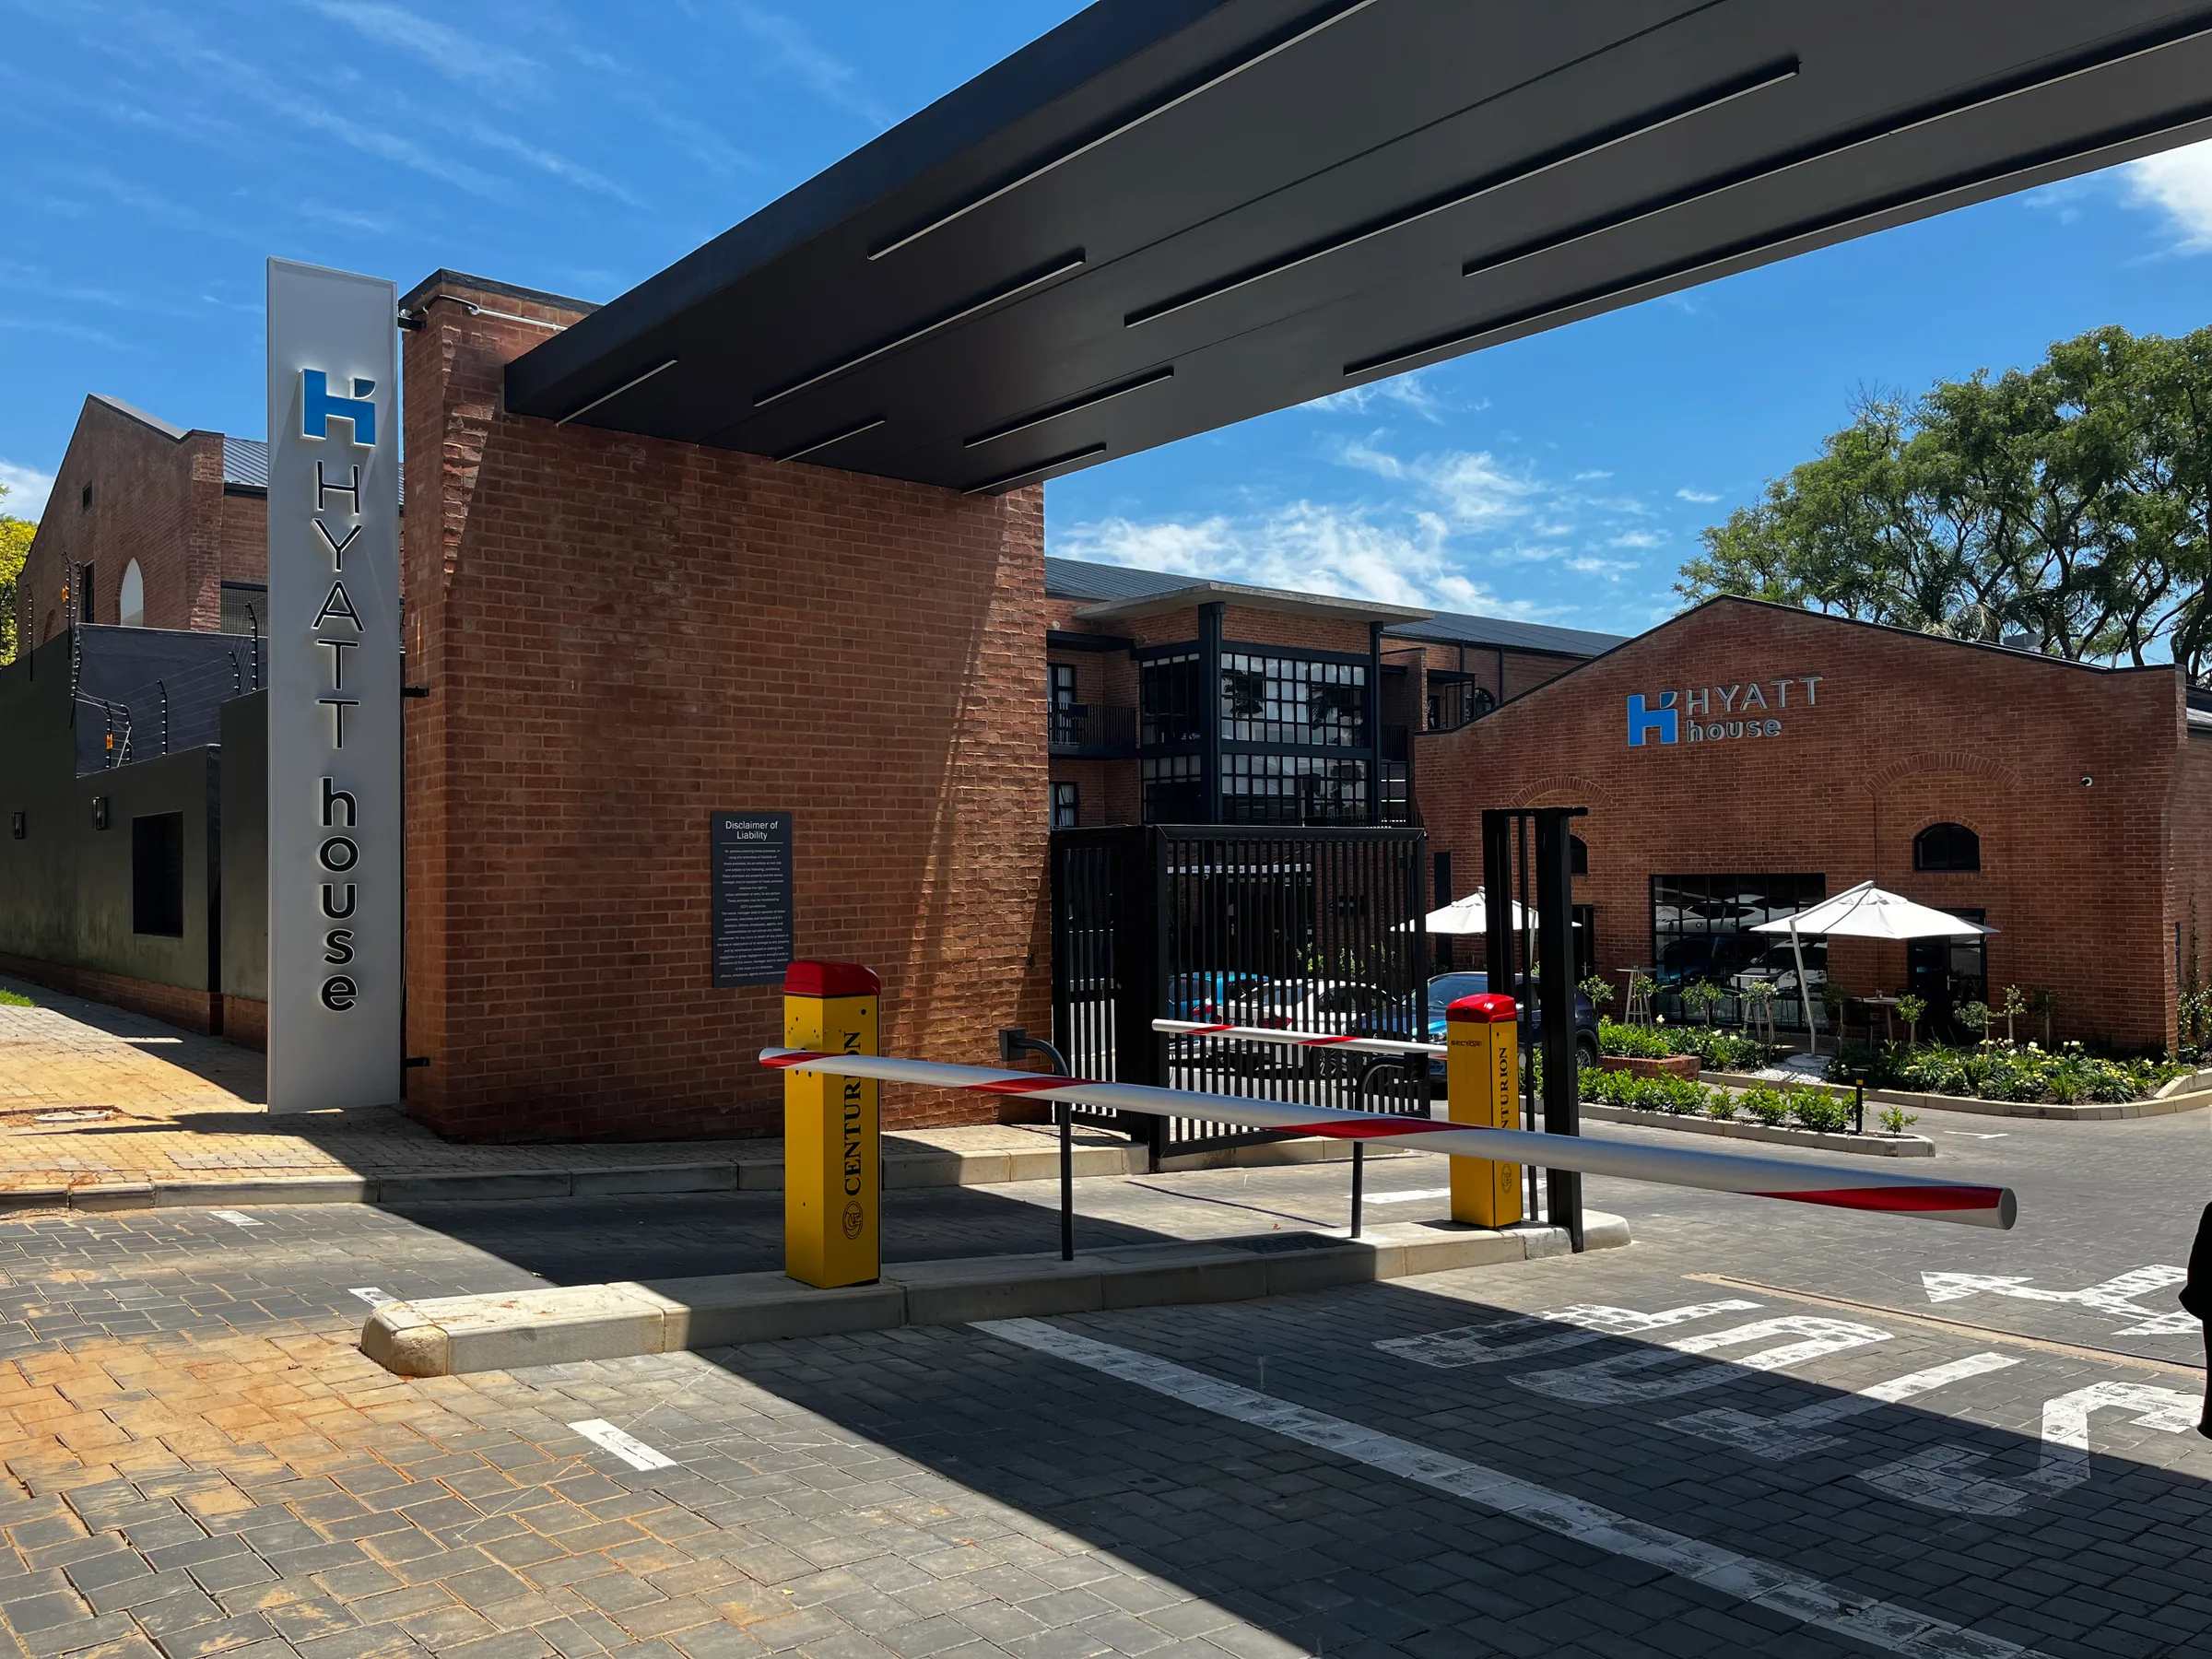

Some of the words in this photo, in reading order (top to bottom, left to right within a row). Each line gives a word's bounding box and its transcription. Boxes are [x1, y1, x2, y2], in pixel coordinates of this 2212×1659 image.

[312, 460, 365, 749] HYATT
[1686, 677, 1823, 715] HYATT
[1686, 718, 1782, 742] house
[725, 820, 769, 830] Disclaimer
[770, 820, 779, 830] of
[736, 830, 768, 841] Liability
[315, 776, 359, 1012] house
[843, 1030, 861, 1196] CENTURIN
[1500, 1047, 1510, 1129] NTURION
